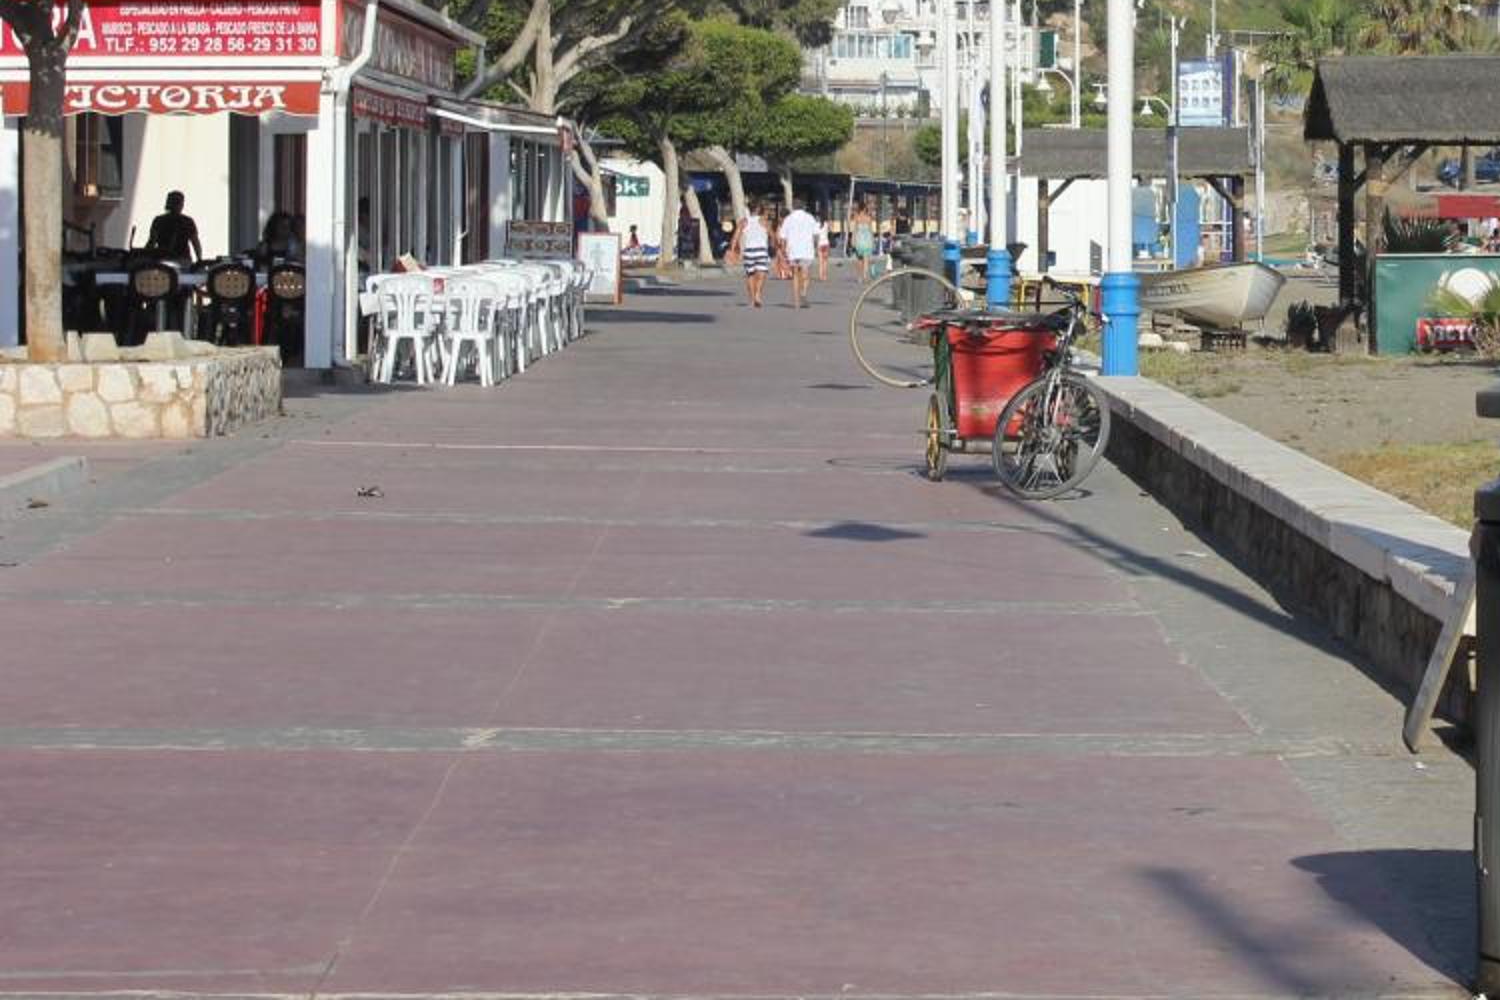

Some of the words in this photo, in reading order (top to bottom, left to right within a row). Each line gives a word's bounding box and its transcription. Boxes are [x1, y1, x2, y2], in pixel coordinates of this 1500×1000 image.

[149, 37, 176, 52] 952
[181, 37, 200, 52] 29
[205, 37, 222, 52] 28
[276, 37, 293, 52] 31
[297, 37, 317, 52] 30
[64, 85, 287, 109] ICTORIA
